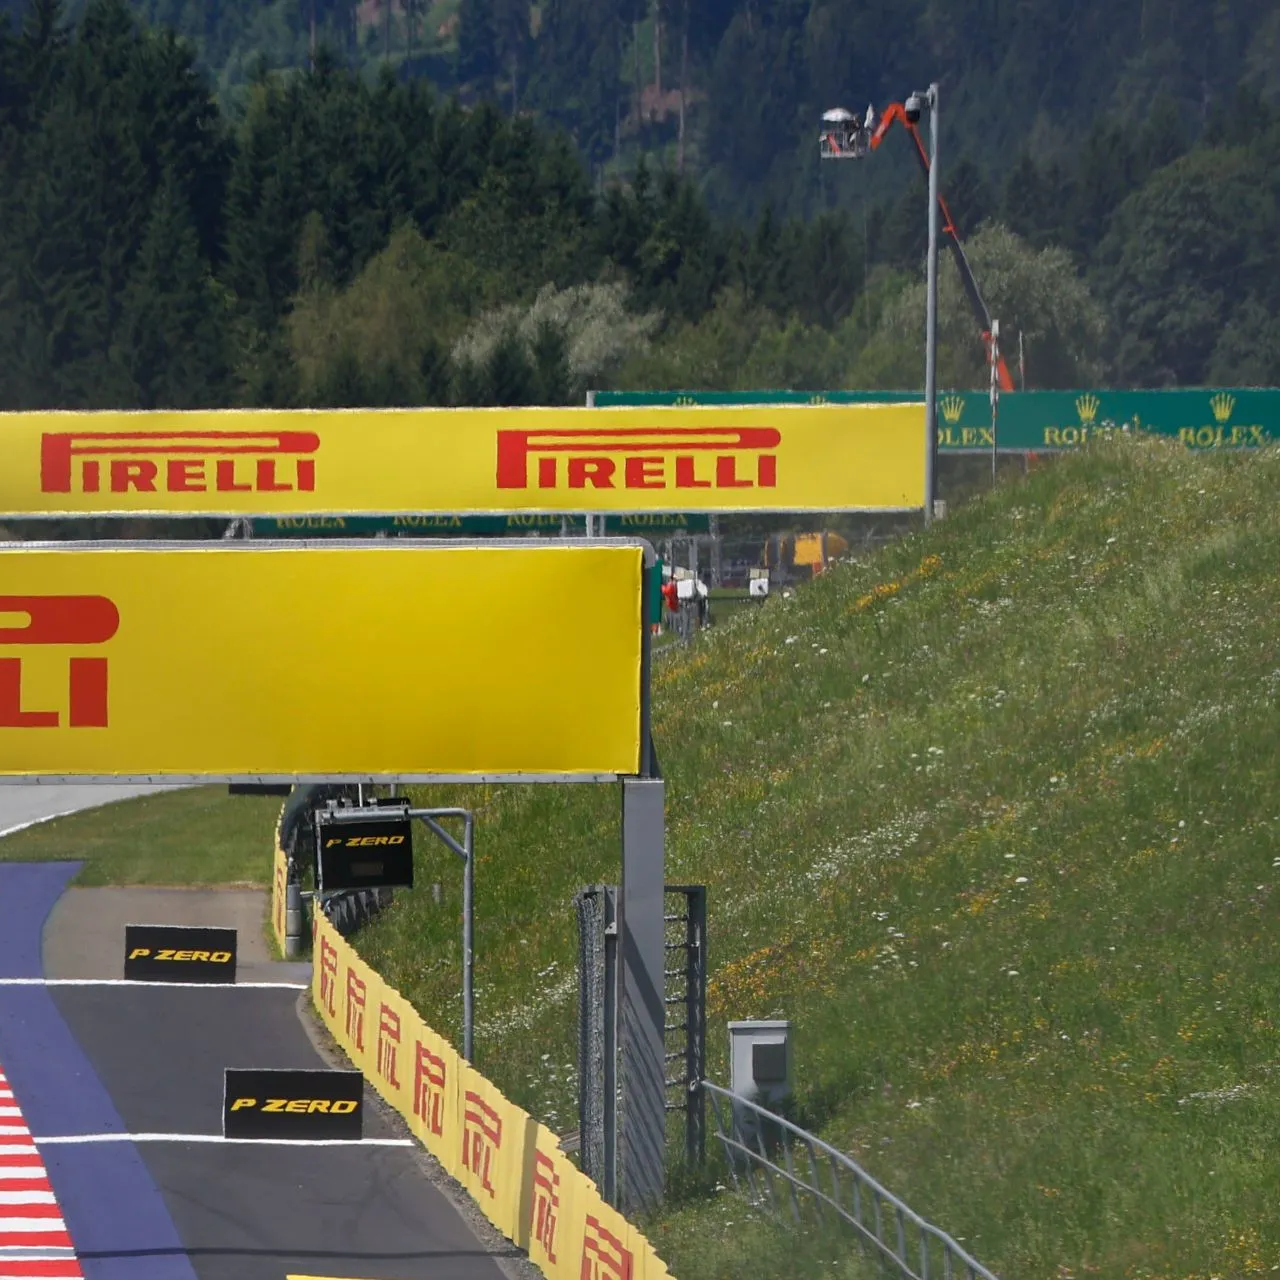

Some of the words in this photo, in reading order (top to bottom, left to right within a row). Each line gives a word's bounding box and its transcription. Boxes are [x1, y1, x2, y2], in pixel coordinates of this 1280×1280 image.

[40, 431, 320, 494] PIRELLI
[495, 427, 781, 490] PIRELLI
[344, 835, 405, 847] ZERO
[128, 948, 151, 960] P
[155, 949, 232, 963] ZERO
[230, 1098, 257, 1112] P
[261, 1098, 359, 1114] ZERO
